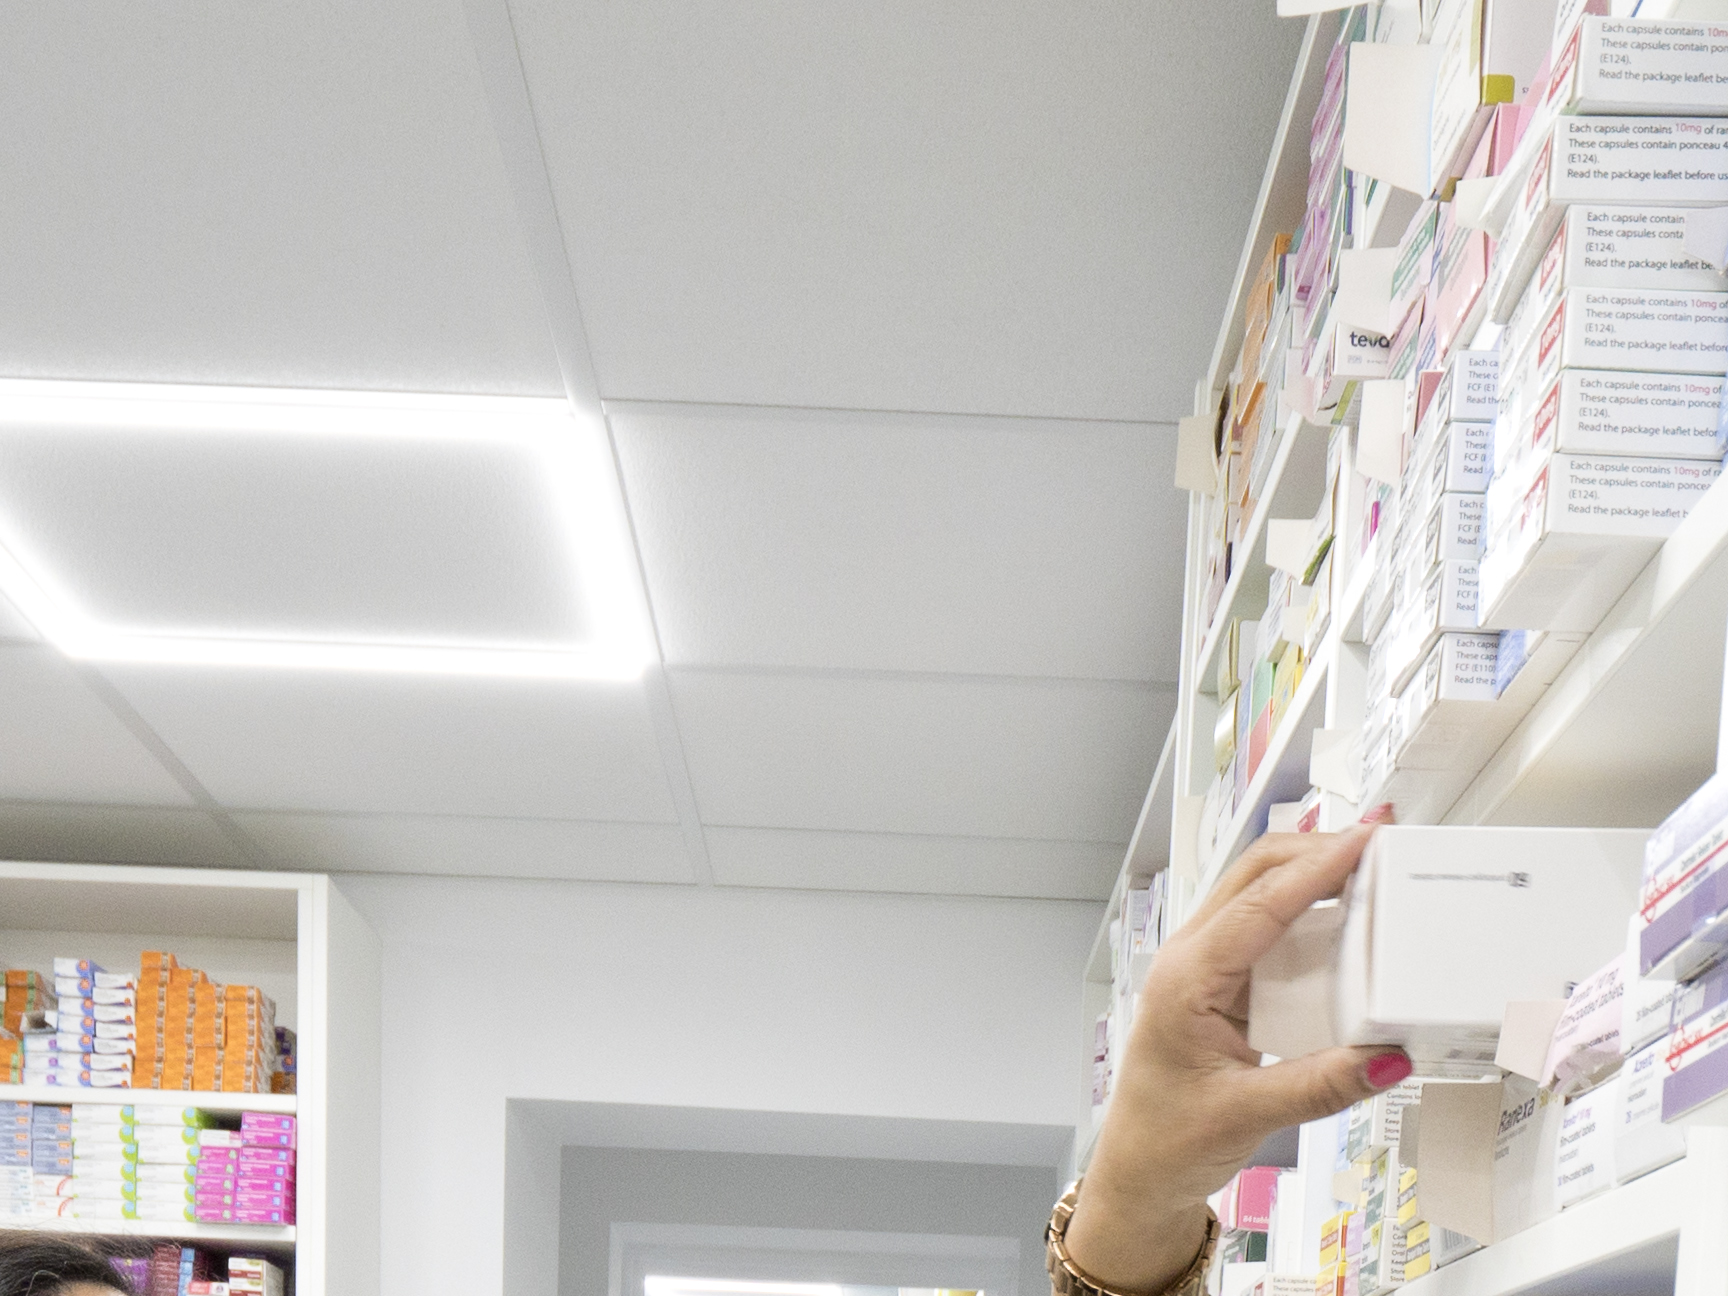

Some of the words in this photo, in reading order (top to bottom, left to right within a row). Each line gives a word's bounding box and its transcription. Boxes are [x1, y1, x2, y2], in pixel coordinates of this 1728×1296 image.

[1602, 23, 1623, 33] Each
[1627, 25, 1662, 36] capsule
[1664, 26, 1704, 36] contains
[1601, 38, 1628, 49] These
[1630, 41, 1671, 51] capsules
[1673, 42, 1708, 52] contain
[1600, 54, 1632, 65] (E124).
[1599, 69, 1622, 79] Read
[1625, 70, 1640, 80] the
[1643, 71, 1682, 84] package
[1684, 73, 1713, 83] leaflet
[1569, 123, 1592, 134] Each
[1593, 124, 1630, 136] capsule
[1632, 125, 1672, 135] contains
[1675, 123, 1702, 135] 10mg
[1704, 125, 1714, 135] of
[1569, 138, 1596, 149] These
[1598, 139, 1639, 150] capsules
[1641, 140, 1677, 150] contain
[1679, 141, 1721, 152] ponceau
[1567, 153, 1600, 164] (E124).
[1567, 169, 1591, 179] Read
[1593, 169, 1609, 179] the
[1611, 170, 1651, 182] package
[1653, 170, 1682, 180] leaflet
[1684, 171, 1716, 181] before
[1580, 378, 1602, 389] Each
[1604, 379, 1640, 391] capsule
[1642, 382, 1681, 392] contains
[1684, 384, 1710, 396] 10mg
[1712, 385, 1722, 395] of
[1580, 393, 1607, 403] These
[1609, 395, 1649, 406] capsules
[1650, 397, 1686, 407] contain
[1688, 399, 1722, 410] poncea
[1578, 407, 1611, 418] (E124).
[1578, 421, 1601, 432] Read
[1604, 422, 1619, 433] the
[1622, 424, 1660, 437] package
[1662, 426, 1691, 436] leaflet
[1693, 427, 1718, 437] befor
[1456, 664, 1470, 672] FCF
